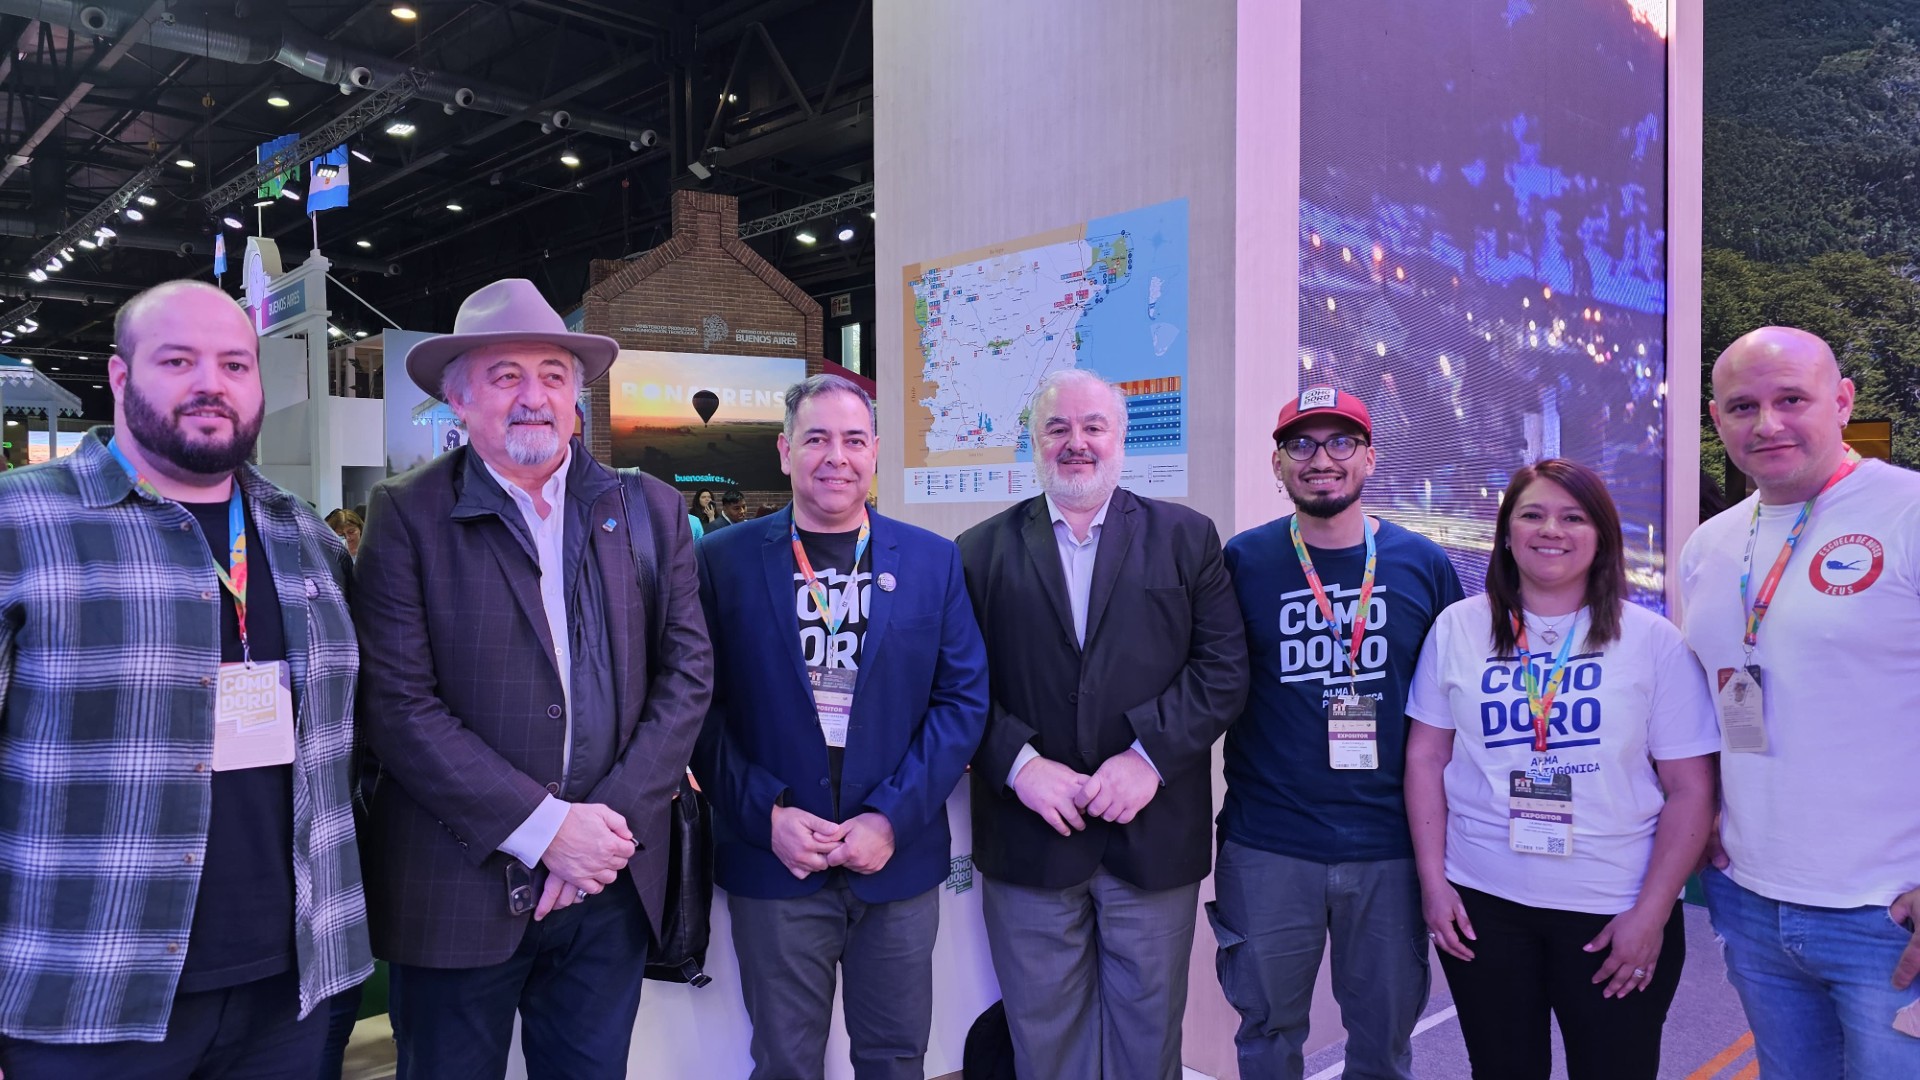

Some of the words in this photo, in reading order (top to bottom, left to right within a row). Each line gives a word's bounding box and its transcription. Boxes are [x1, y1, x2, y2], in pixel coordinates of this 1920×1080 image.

[269, 297, 286, 316] BUENOS
[287, 290, 300, 308] AIRES
[736, 334, 771, 343] BUENOS
[773, 336, 798, 345] AIRES
[1819, 536, 1854, 556] ESCUELA
[1855, 536, 1868, 544] DE
[1825, 585, 1854, 595] ZEUS
[797, 582, 871, 624] OM
[1279, 596, 1387, 635] COMO
[799, 626, 868, 670] OR
[1280, 635, 1388, 673] DORO
[222, 673, 274, 694] COMO
[1481, 662, 1602, 696] COMO
[222, 690, 274, 711] DORO
[1322, 687, 1349, 699] ALMA
[817, 705, 843, 713] POSITOR
[1481, 697, 1601, 736] DORO
[1521, 812, 1562, 821] EXPOSITOR
[947, 870, 971, 884] DORO
